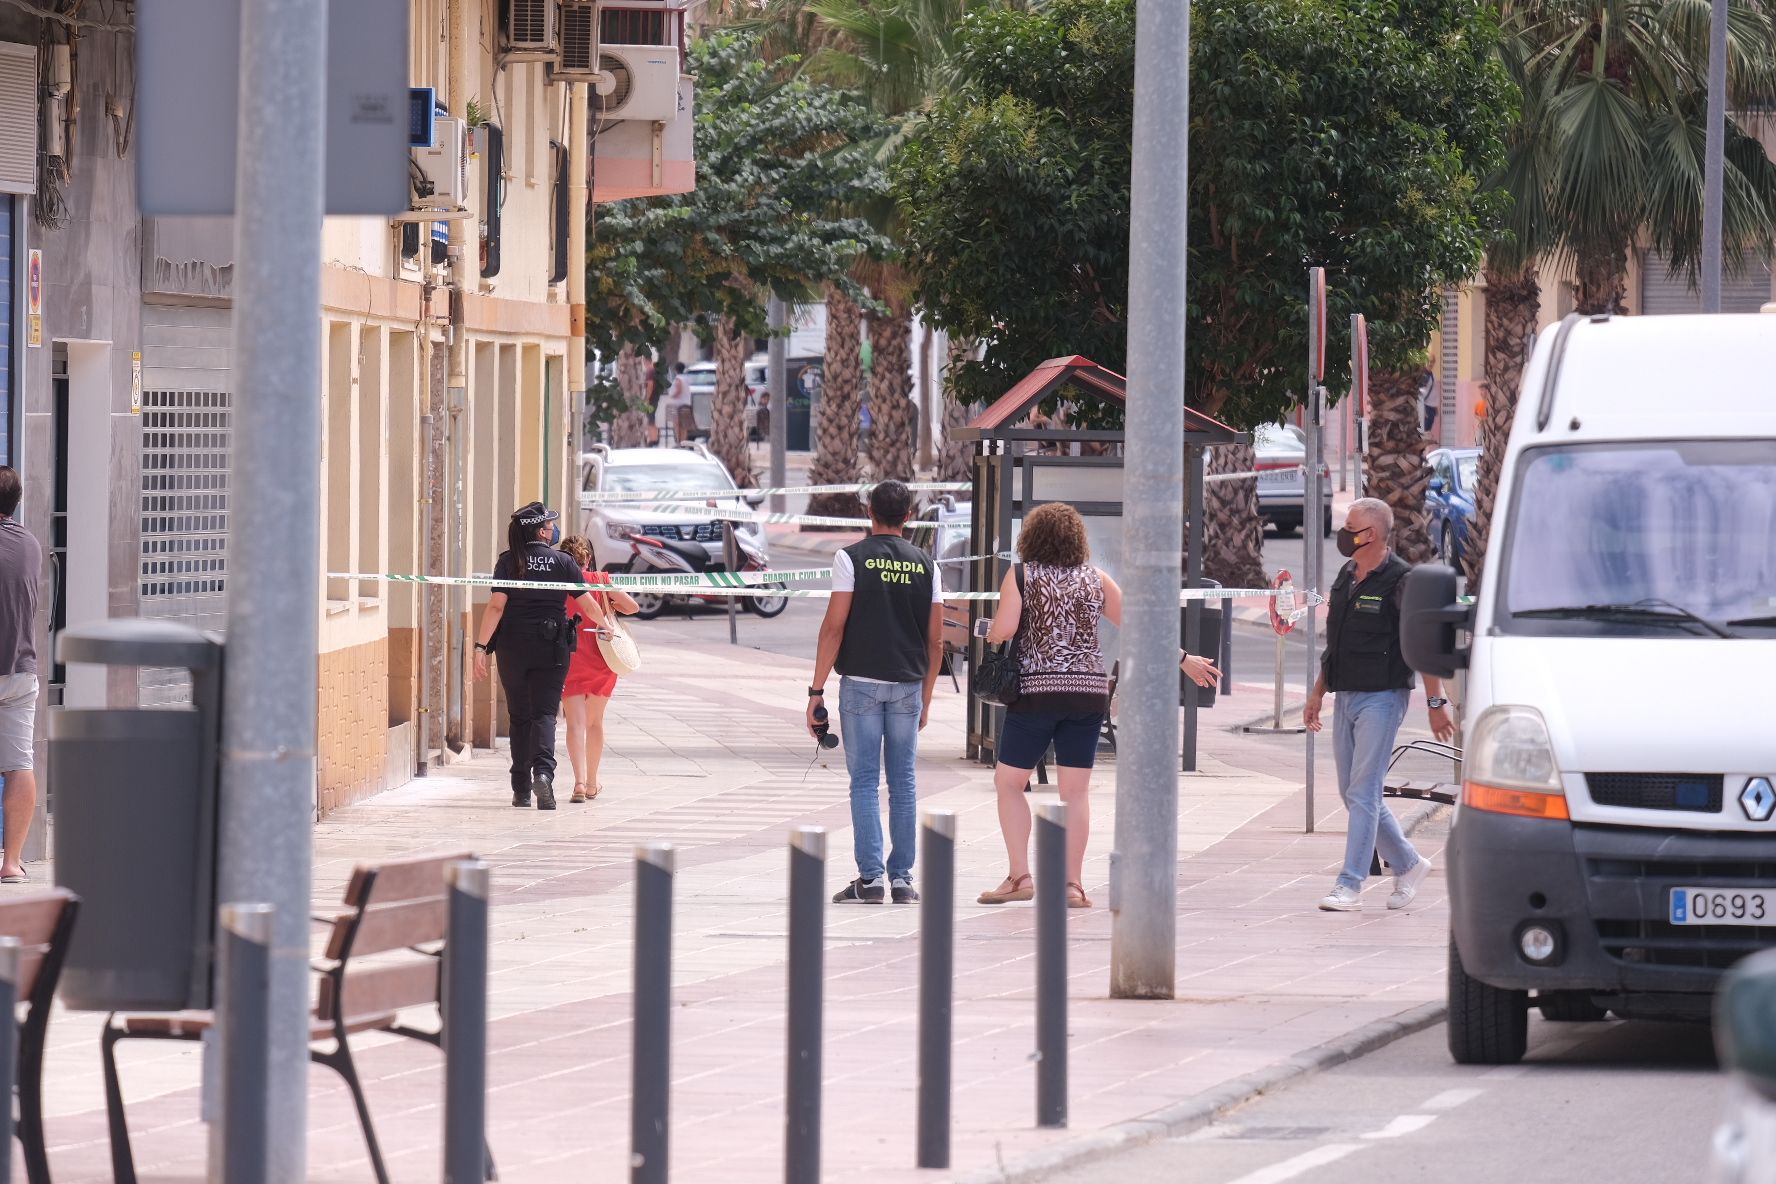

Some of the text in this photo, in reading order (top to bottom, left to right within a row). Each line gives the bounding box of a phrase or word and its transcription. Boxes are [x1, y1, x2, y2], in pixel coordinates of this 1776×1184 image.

[526, 555, 556, 564] LICIA
[527, 562, 552, 572] OCAL
[864, 558, 925, 574] GUARDIA
[640, 576, 658, 586] CIVIL
[661, 576, 672, 586] NO
[674, 575, 700, 585] PASAR
[762, 570, 831, 582] GUARDIA CIVIL NO
[880, 570, 912, 584] CIVIL
[1692, 892, 1765, 920] 0693
